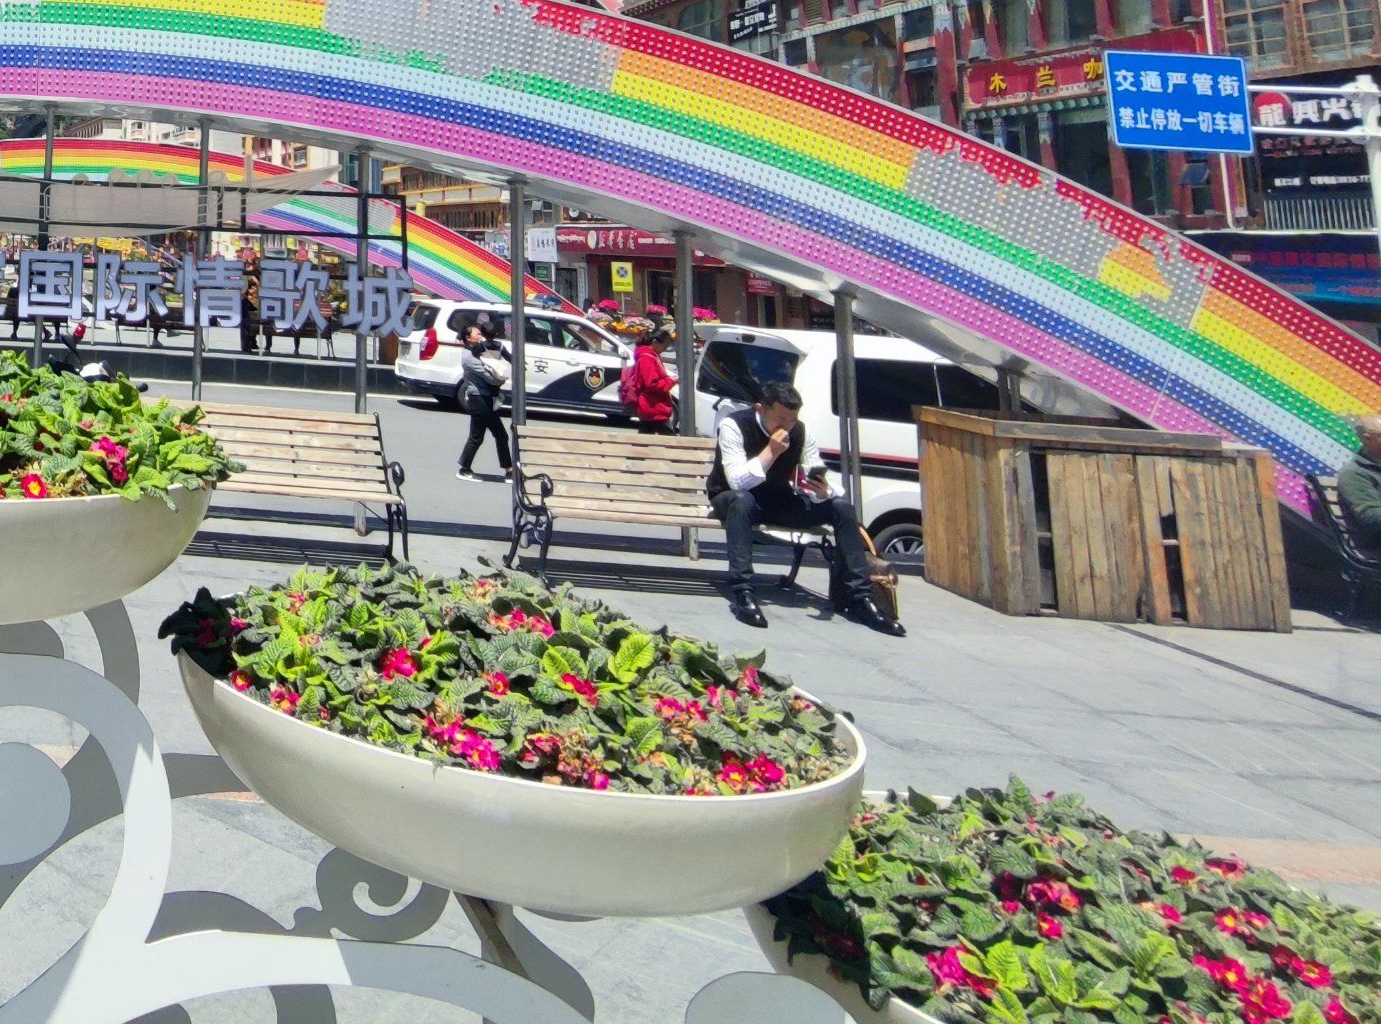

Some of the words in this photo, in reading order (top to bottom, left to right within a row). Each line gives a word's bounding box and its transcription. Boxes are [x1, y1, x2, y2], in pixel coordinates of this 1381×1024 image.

[1114, 69, 1240, 98] 交通严管街
[1118, 107, 1246, 135] 禁止停放一切车辆
